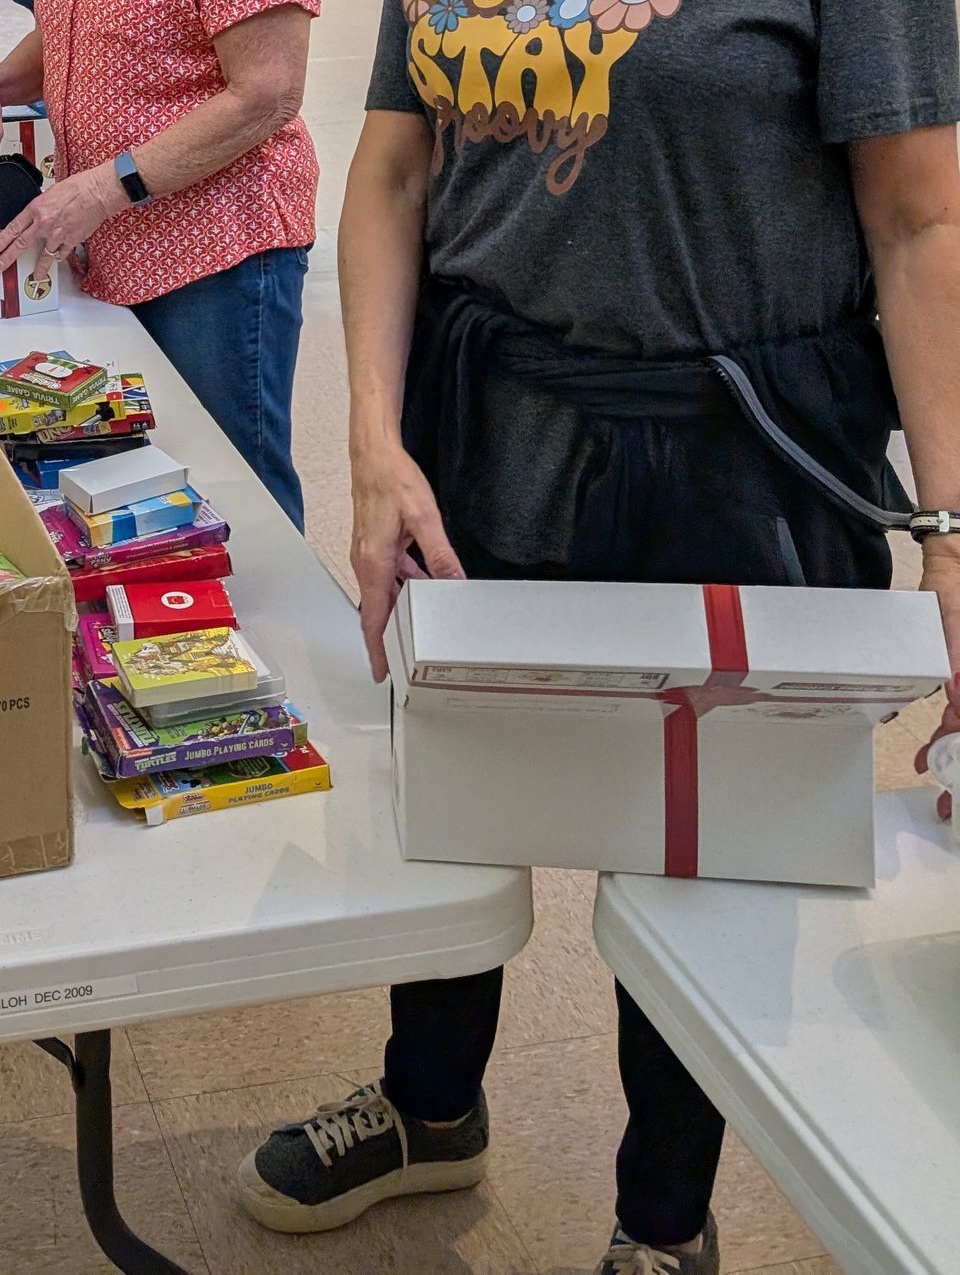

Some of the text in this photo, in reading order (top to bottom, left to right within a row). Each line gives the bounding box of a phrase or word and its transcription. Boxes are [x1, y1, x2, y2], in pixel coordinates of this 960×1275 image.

[408, 13, 638, 133] STAY
[6, 385, 60, 405] TRIVIA GAME
[9, 697, 30, 710] PCS
[228, 786, 290, 804] PLAYING CARDS
[245, 782, 273, 794] JUMBO
[35, 990, 61, 1004] DEC
[64, 985, 93, 1000] 2009
